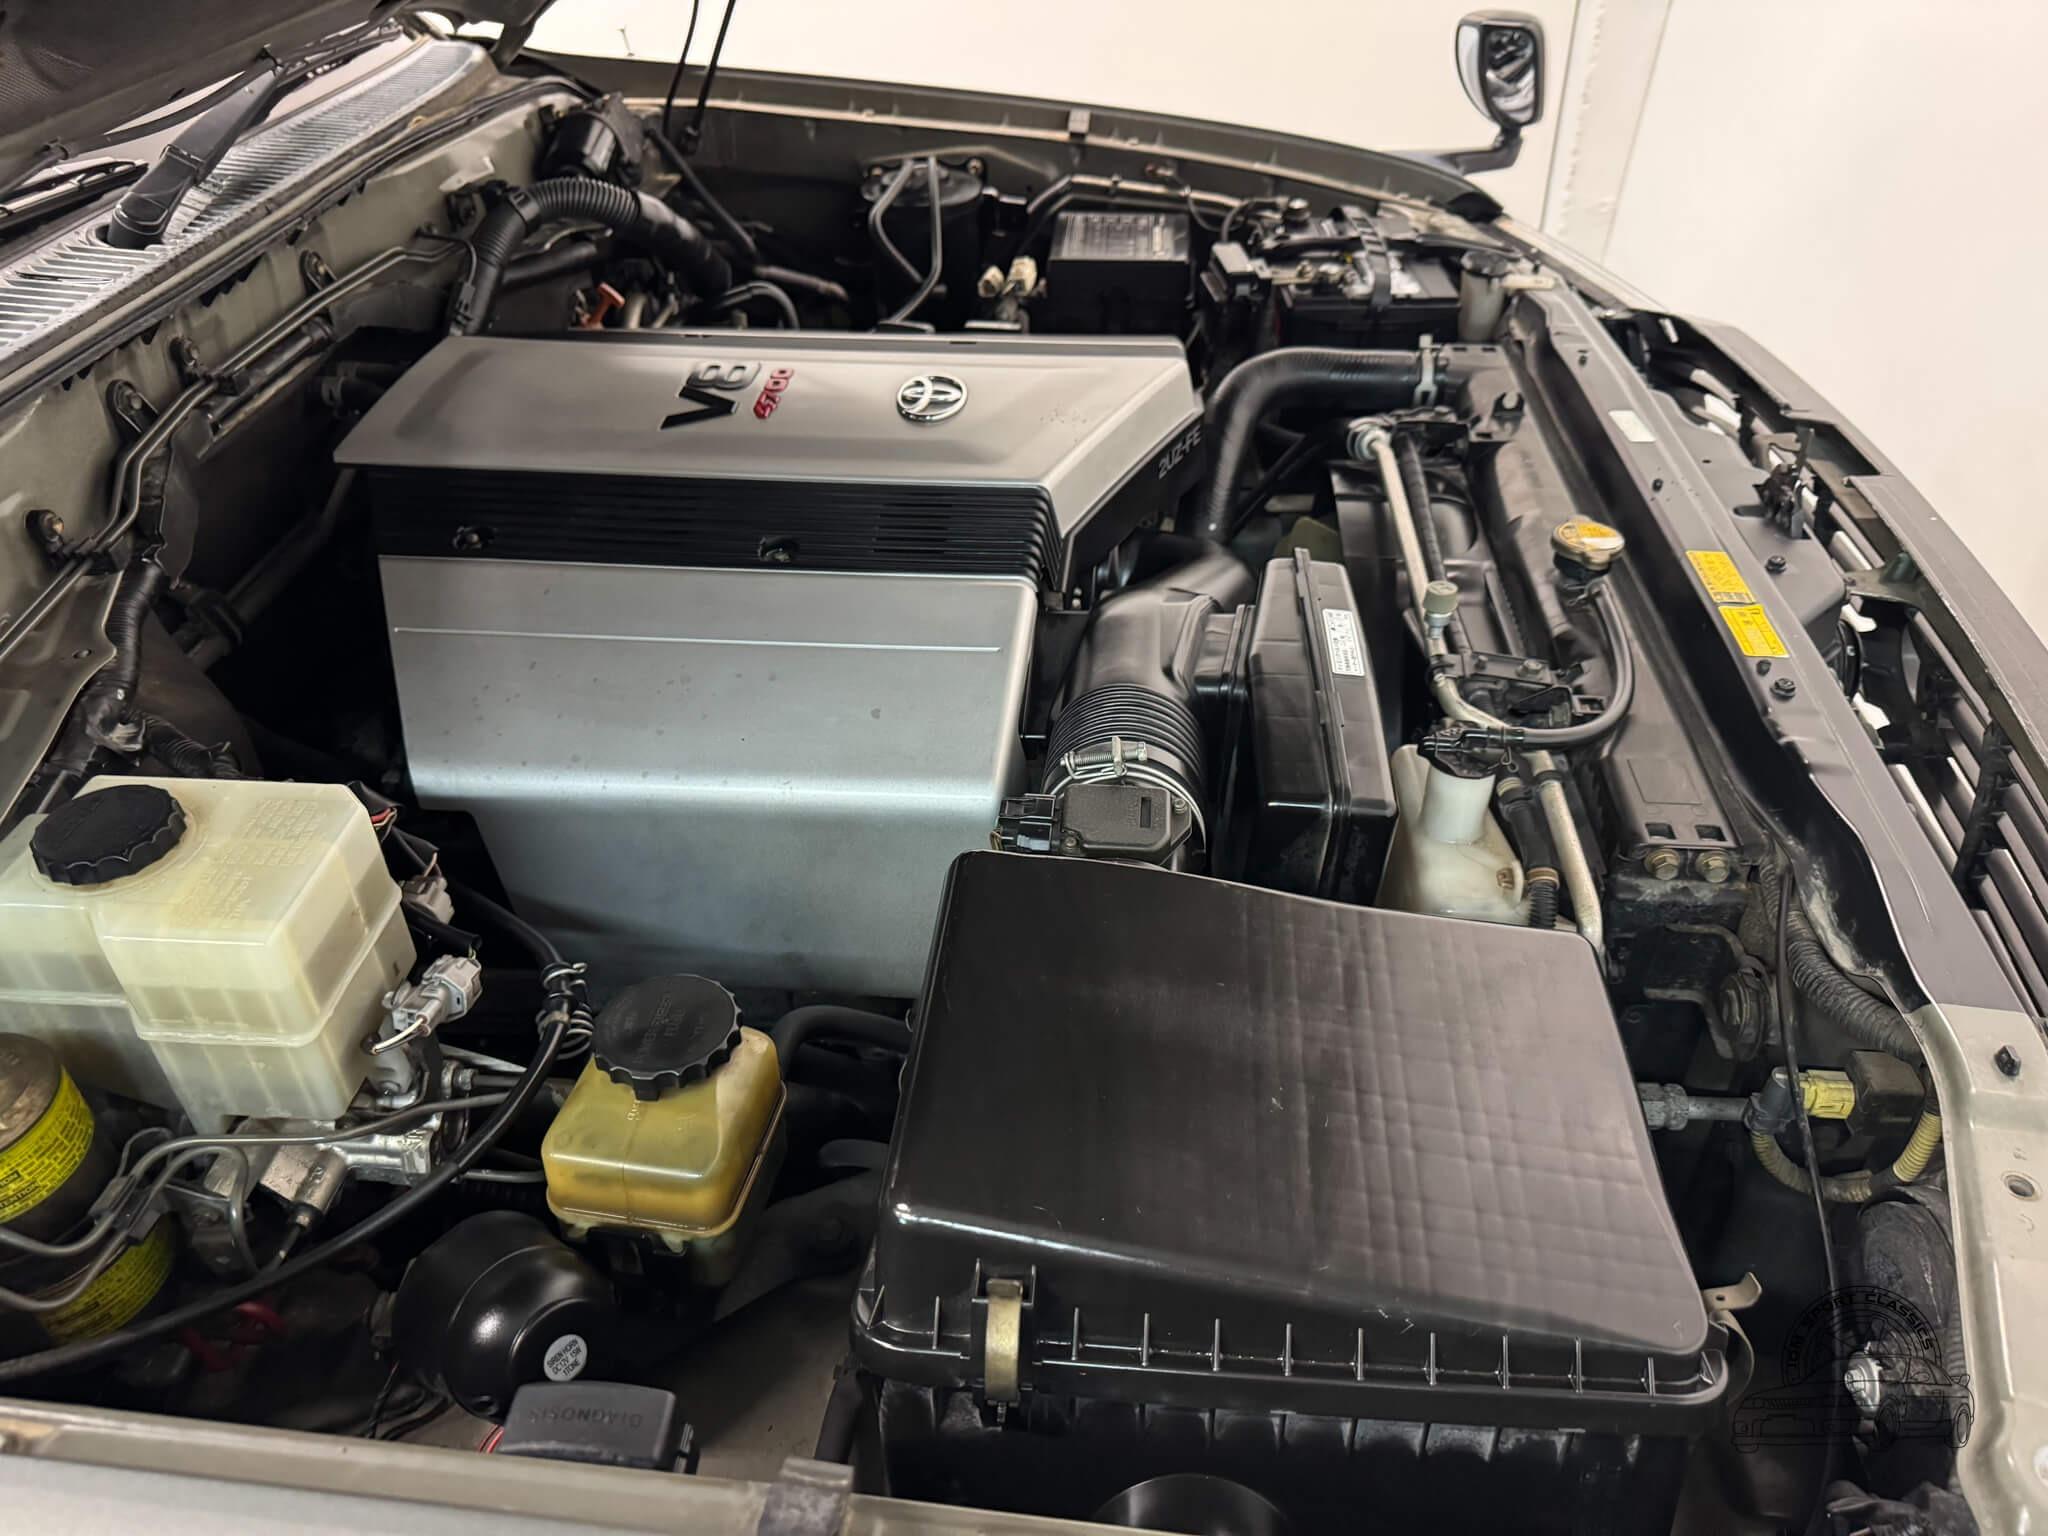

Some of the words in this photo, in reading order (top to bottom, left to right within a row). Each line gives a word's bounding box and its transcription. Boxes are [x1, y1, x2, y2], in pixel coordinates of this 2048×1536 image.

[660, 360, 762, 430] V8
[562, 1338, 579, 1356] HORN
[529, 1406, 643, 1430] DIAGNOSIS
